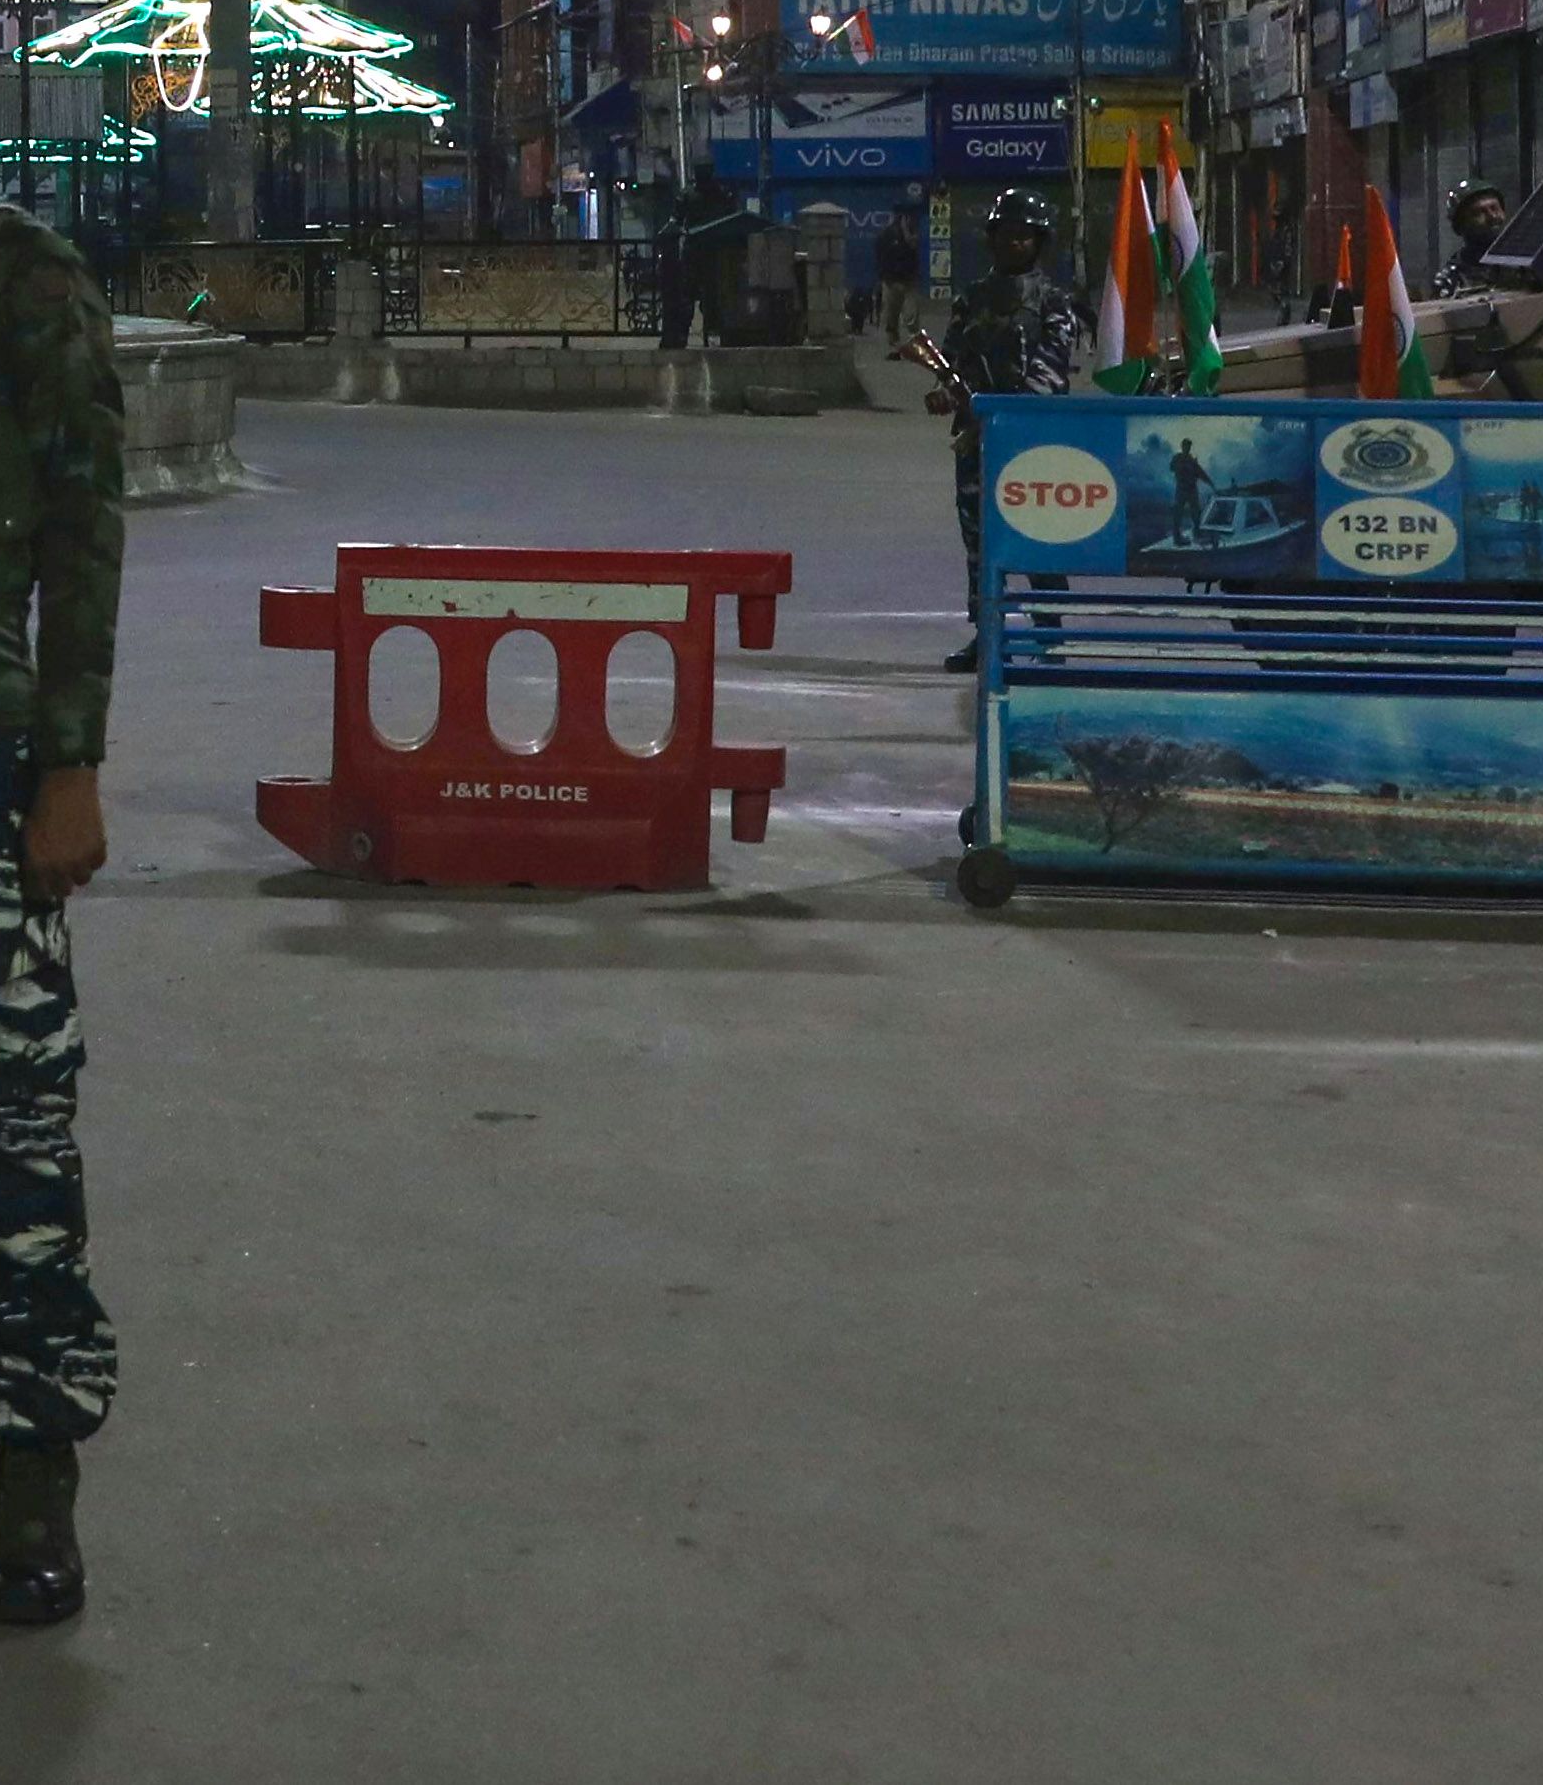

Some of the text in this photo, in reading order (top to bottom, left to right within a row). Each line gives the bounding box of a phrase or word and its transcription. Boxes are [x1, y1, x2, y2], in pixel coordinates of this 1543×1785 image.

[909, 43, 974, 63] Dharam
[797, 142, 886, 168] vivo
[966, 139, 1047, 162] Galaxy
[1003, 481, 1109, 508] STOP
[1338, 515, 1437, 534] 132 BN
[1355, 542, 1430, 561] CRPF
[439, 781, 589, 803] J&K POLICE
